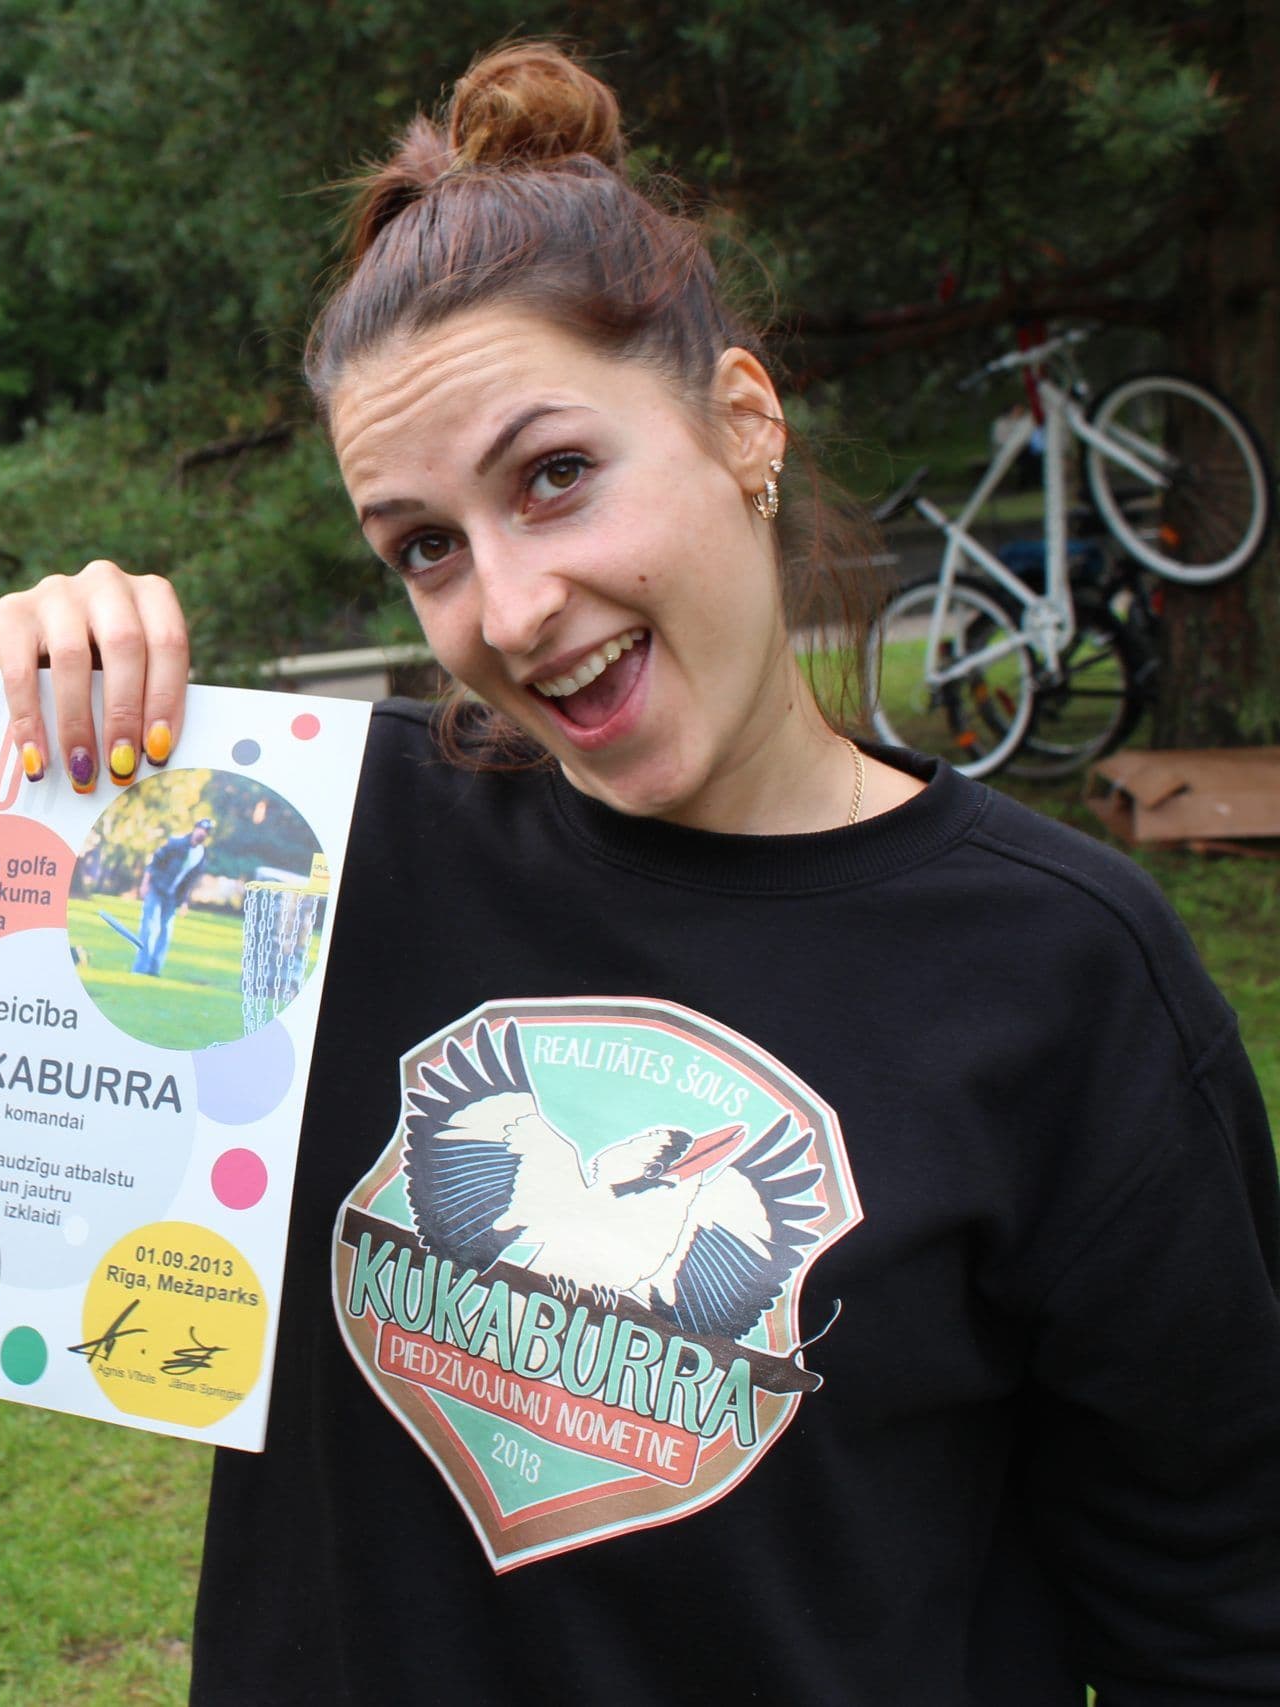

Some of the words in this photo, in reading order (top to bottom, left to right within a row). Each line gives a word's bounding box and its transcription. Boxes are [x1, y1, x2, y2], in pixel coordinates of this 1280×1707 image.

[6, 856, 58, 880] golfa
[534, 1034, 673, 1085] REALITĀTES
[677, 1056, 749, 1116] ŠOVS
[4, 1104, 84, 1131] komandai
[65, 1162, 135, 1188] atbalstu
[0, 1179, 19, 1194] un
[21, 1181, 72, 1204] jautru
[3, 1201, 61, 1226] izklaidi
[135, 1245, 234, 1277] 01.09.2013
[106, 1265, 151, 1291] Rīga,
[157, 1273, 259, 1307] Mežaparks
[348, 1232, 758, 1448] KUKABURRA
[389, 1335, 551, 1426] PIEDZĪVOJUMU
[556, 1402, 684, 1472] NOMETNE
[491, 1432, 542, 1484] 2013
